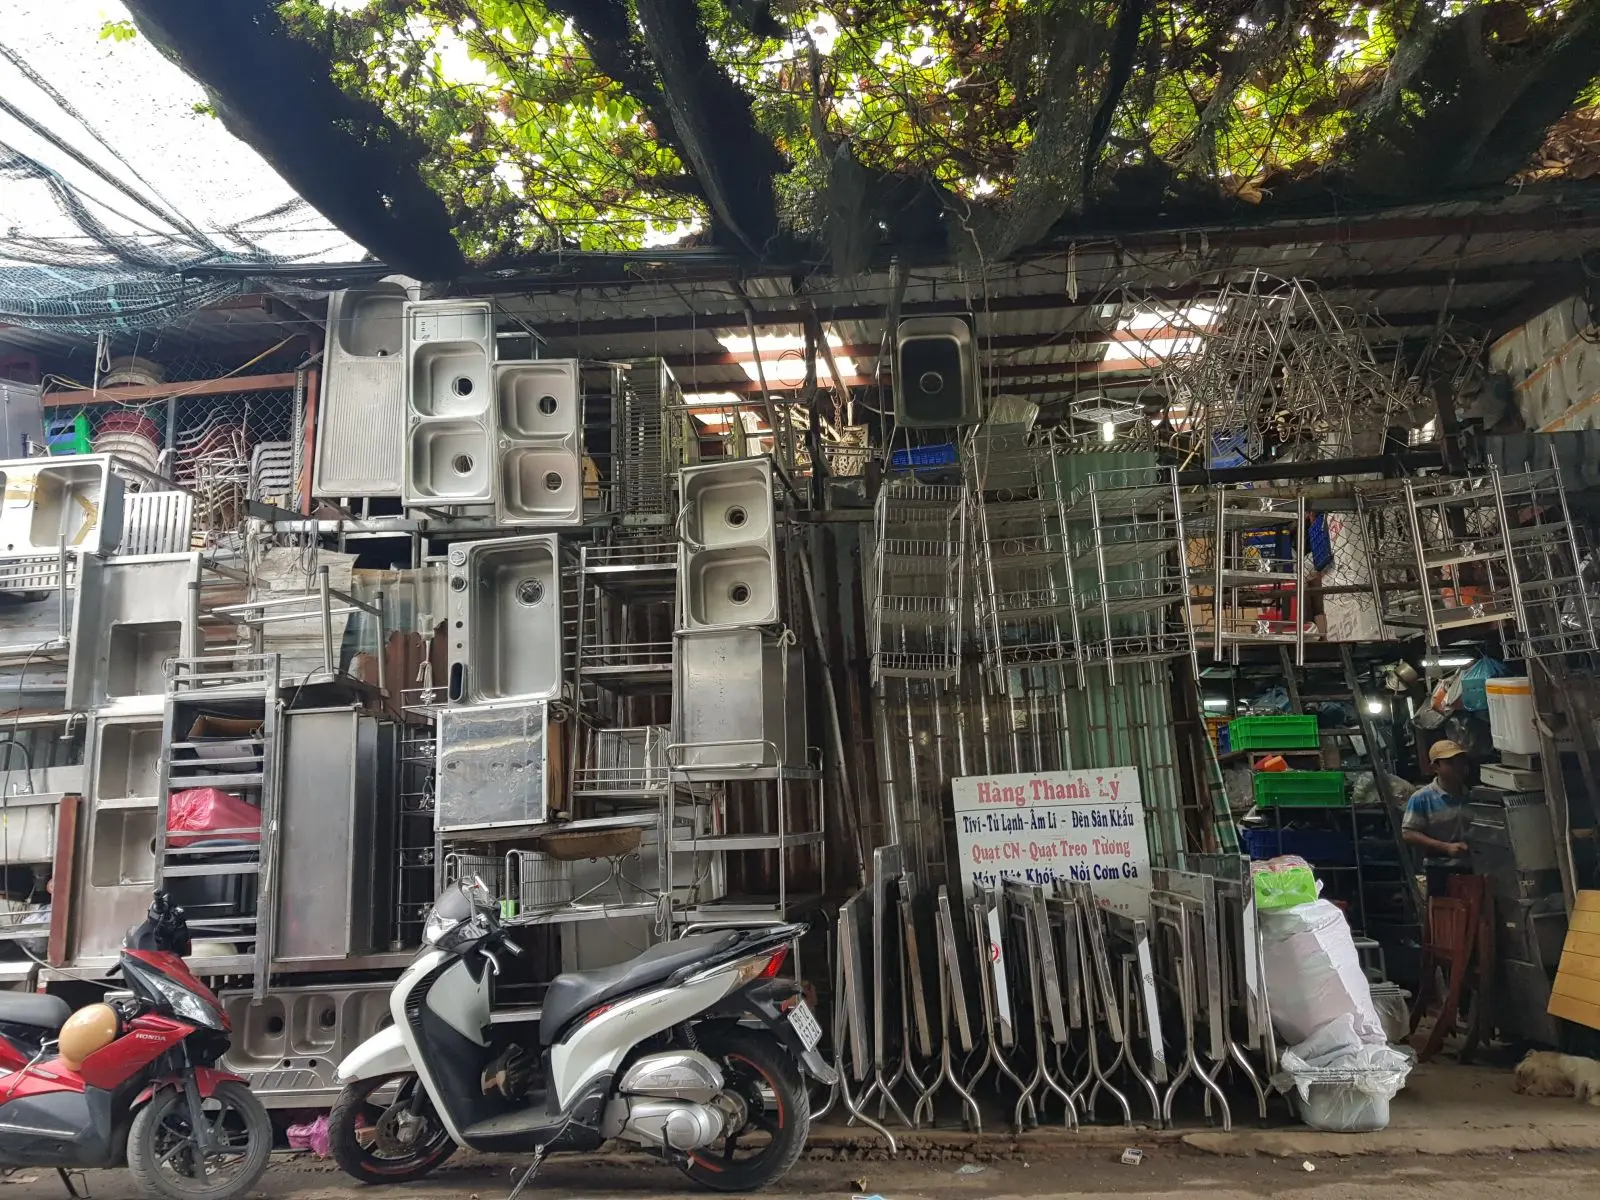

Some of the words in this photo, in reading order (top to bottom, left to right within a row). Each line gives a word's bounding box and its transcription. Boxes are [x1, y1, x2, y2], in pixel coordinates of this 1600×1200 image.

[977, 781, 1026, 807] Hàng
[1029, 777, 1091, 800] Thanh
[1003, 842, 1020, 859] CN
[1060, 840, 1088, 857] Treo
[1093, 863, 1119, 880] Cơm
[135, 1033, 166, 1041] HONDA
